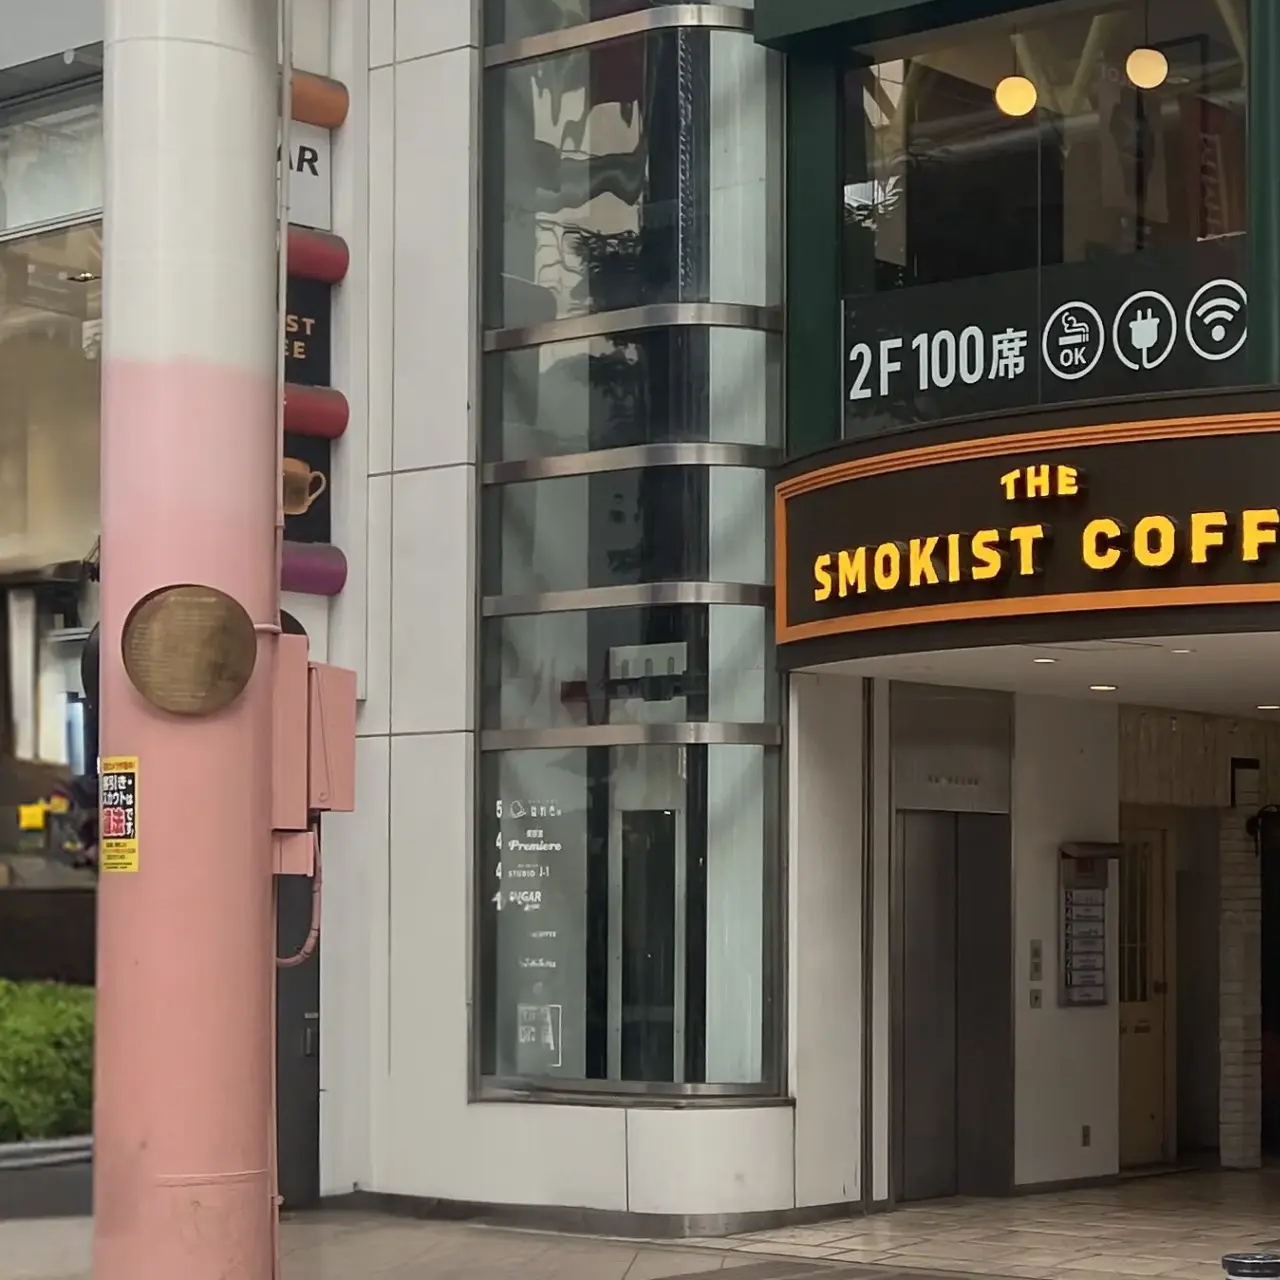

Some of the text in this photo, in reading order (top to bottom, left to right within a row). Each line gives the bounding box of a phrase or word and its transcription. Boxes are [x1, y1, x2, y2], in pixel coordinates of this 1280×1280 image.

[849, 326, 1029, 401] 2F 100席
[1059, 346, 1088, 367] OK
[1000, 463, 1079, 500] THE
[813, 524, 1045, 602] SMOKIST
[508, 839, 562, 852] Premiere
